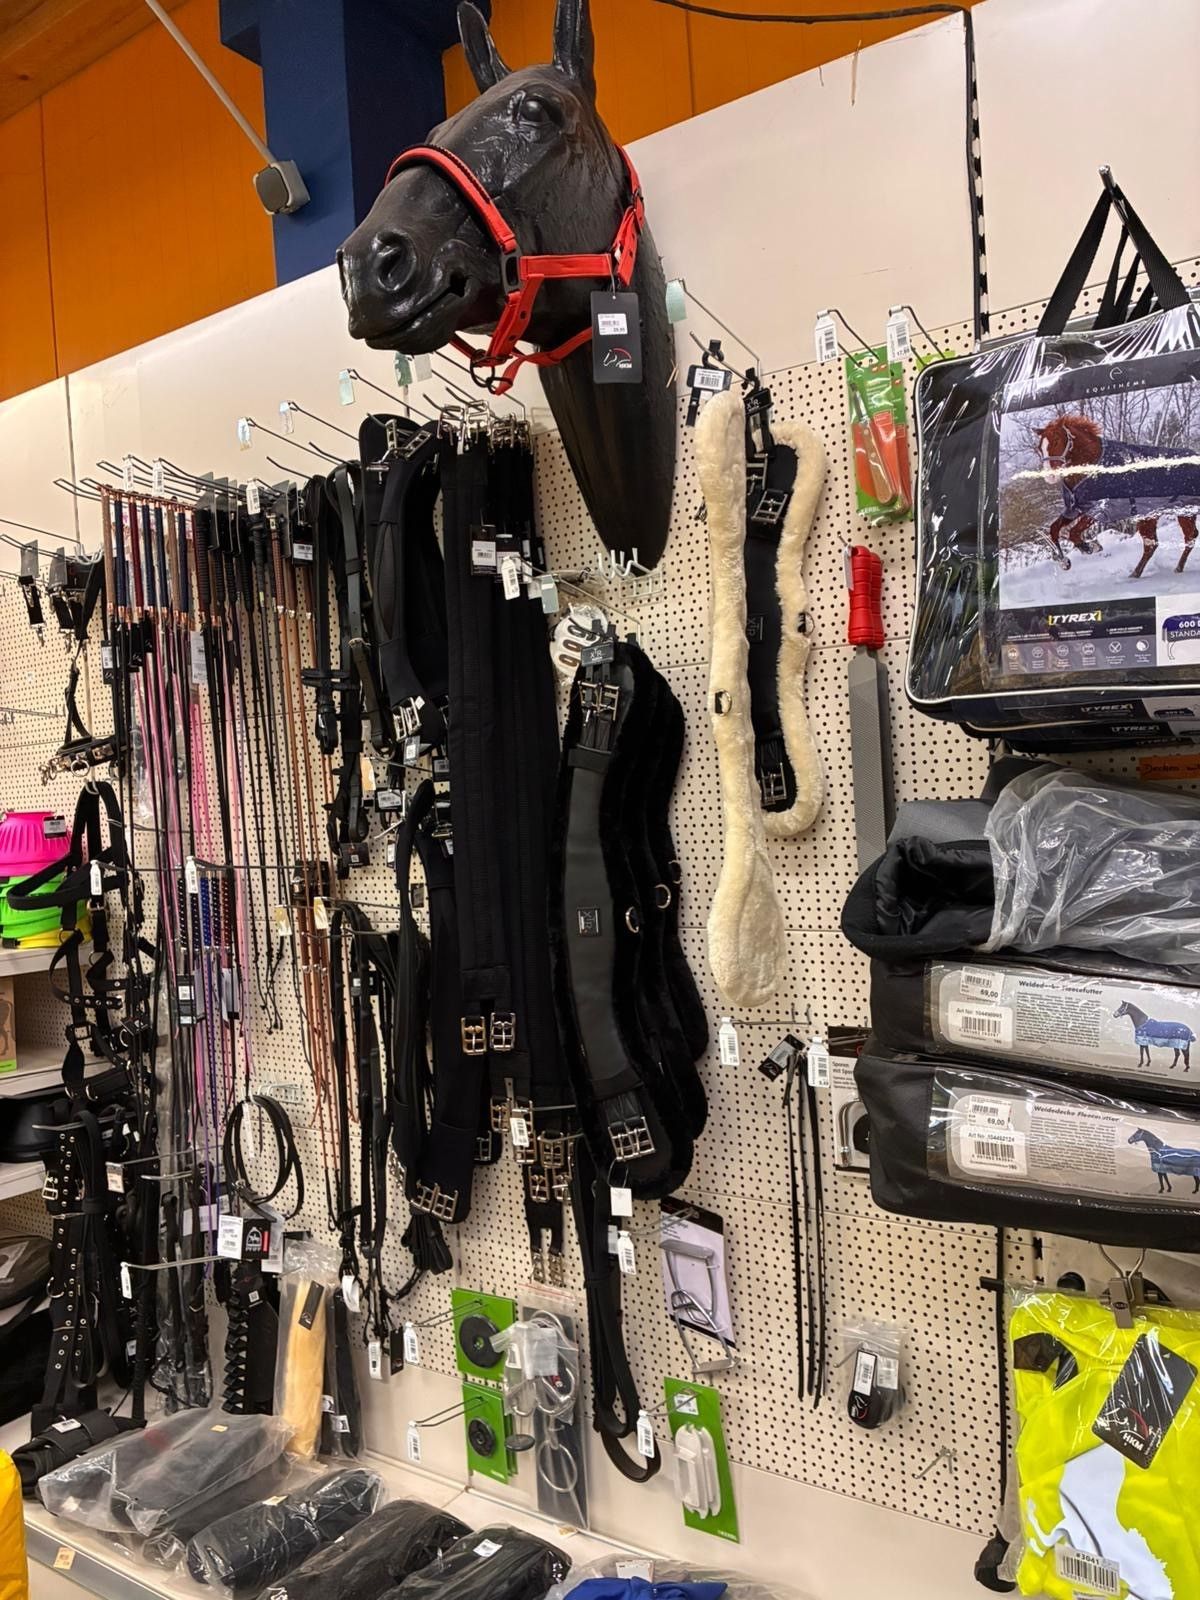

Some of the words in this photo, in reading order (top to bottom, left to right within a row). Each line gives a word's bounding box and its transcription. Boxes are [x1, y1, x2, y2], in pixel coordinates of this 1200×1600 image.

[1179, 621, 1195, 629] 600
[980, 989, 999, 998] 69,00
[987, 1117, 1005, 1126] 69,00
[1122, 1432, 1144, 1451] HKM
